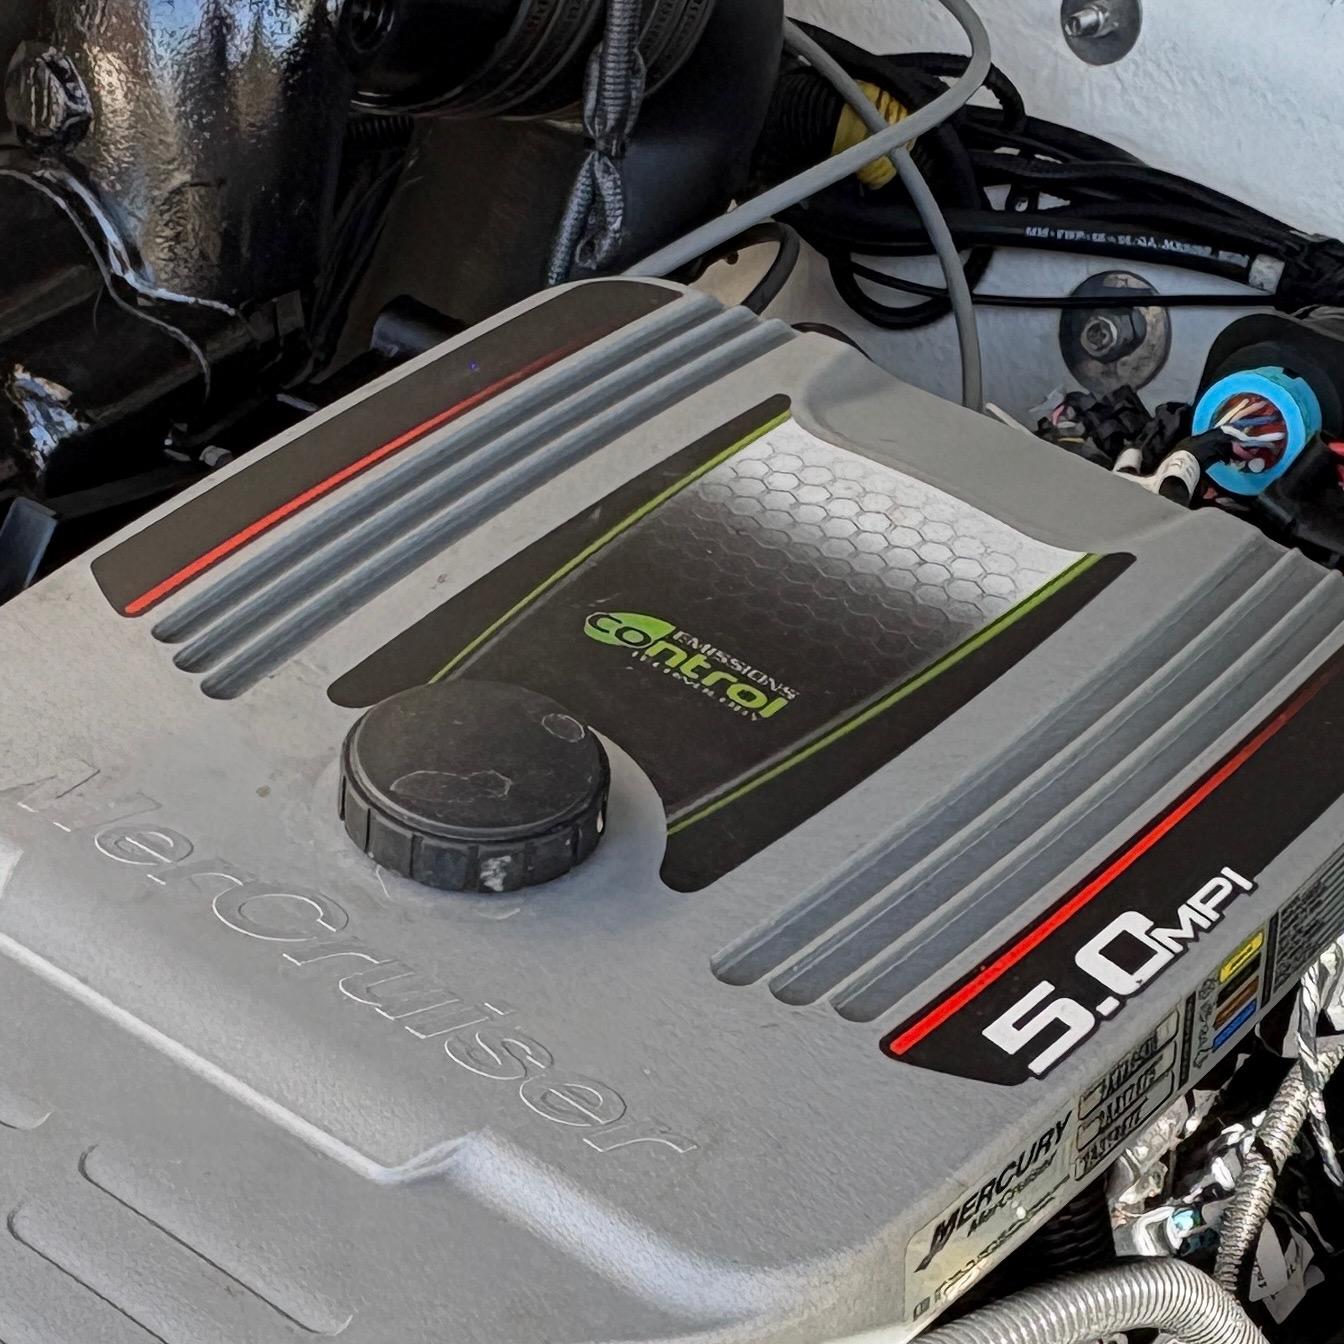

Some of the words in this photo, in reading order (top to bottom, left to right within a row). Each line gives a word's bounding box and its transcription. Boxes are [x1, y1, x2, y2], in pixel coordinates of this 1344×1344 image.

[586, 612, 789, 719] control
[672, 630, 800, 700] EMISSIONS
[914, 1109, 1073, 1273] MERCURY
